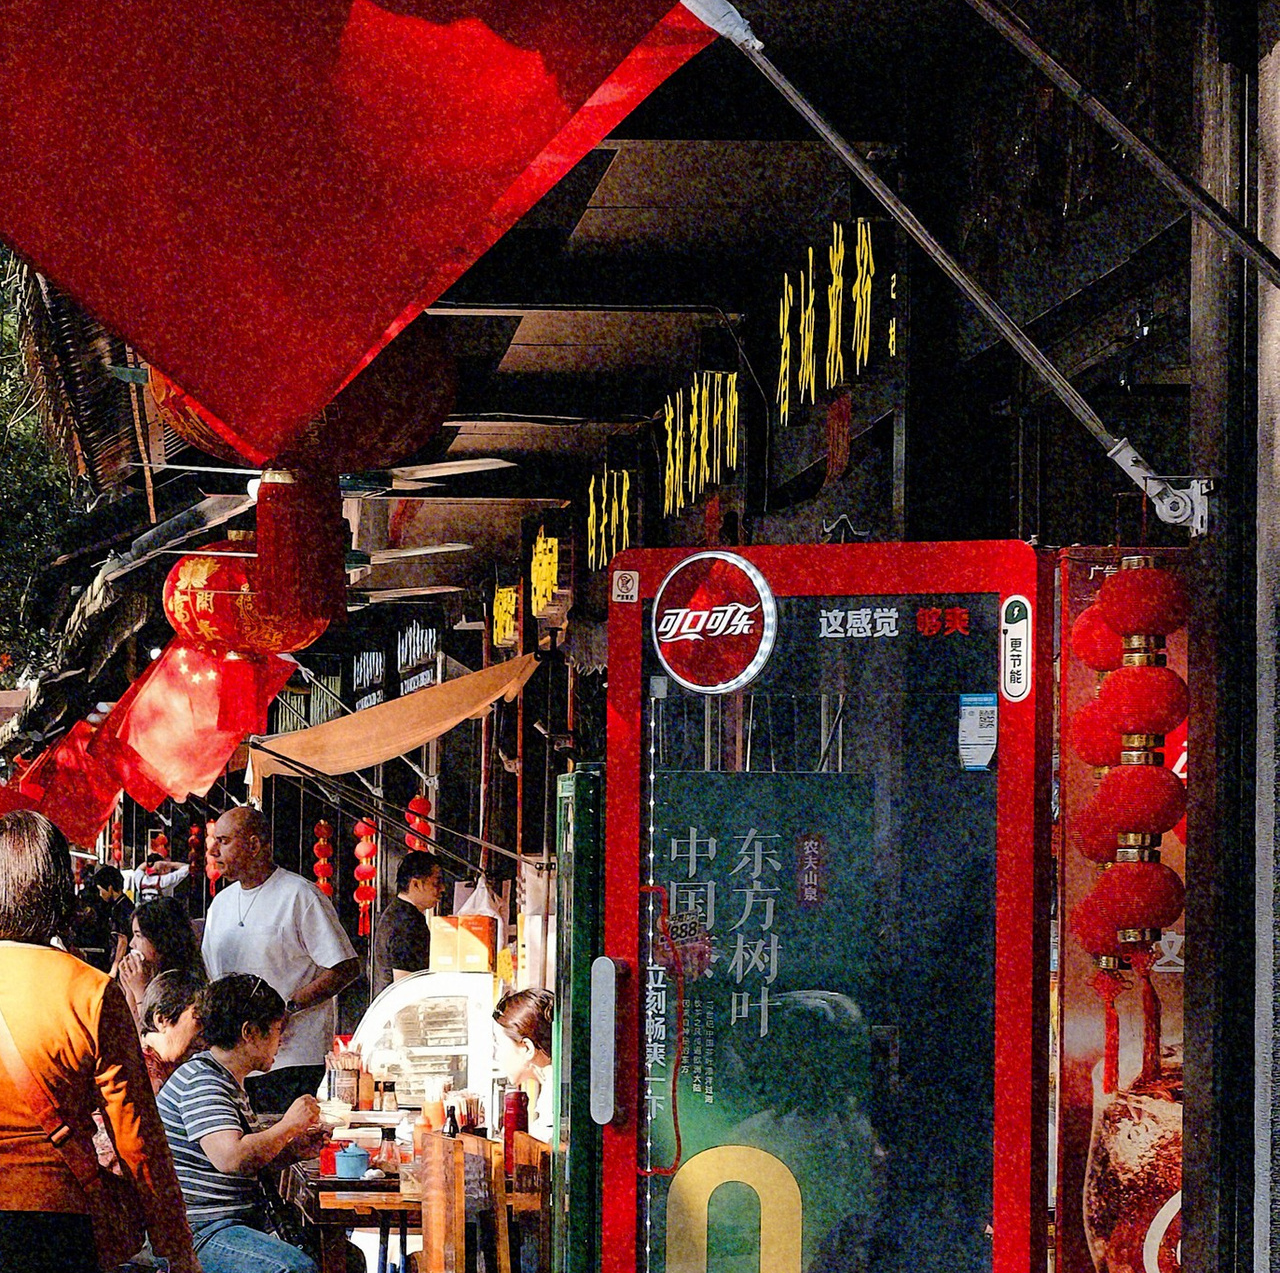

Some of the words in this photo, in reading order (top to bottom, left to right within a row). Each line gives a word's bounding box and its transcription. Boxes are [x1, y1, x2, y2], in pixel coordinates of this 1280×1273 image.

[658, 602, 761, 642] 可口可乐
[819, 608, 899, 638] 这感觉
[916, 607, 970, 636] 够爽
[1009, 638, 1023, 684] 更节能
[803, 839, 819, 901] 农夫山泉
[669, 921, 698, 941] 888
[727, 827, 783, 1037] 东方树叶
[644, 964, 667, 1119] 立刻畅爽一下
